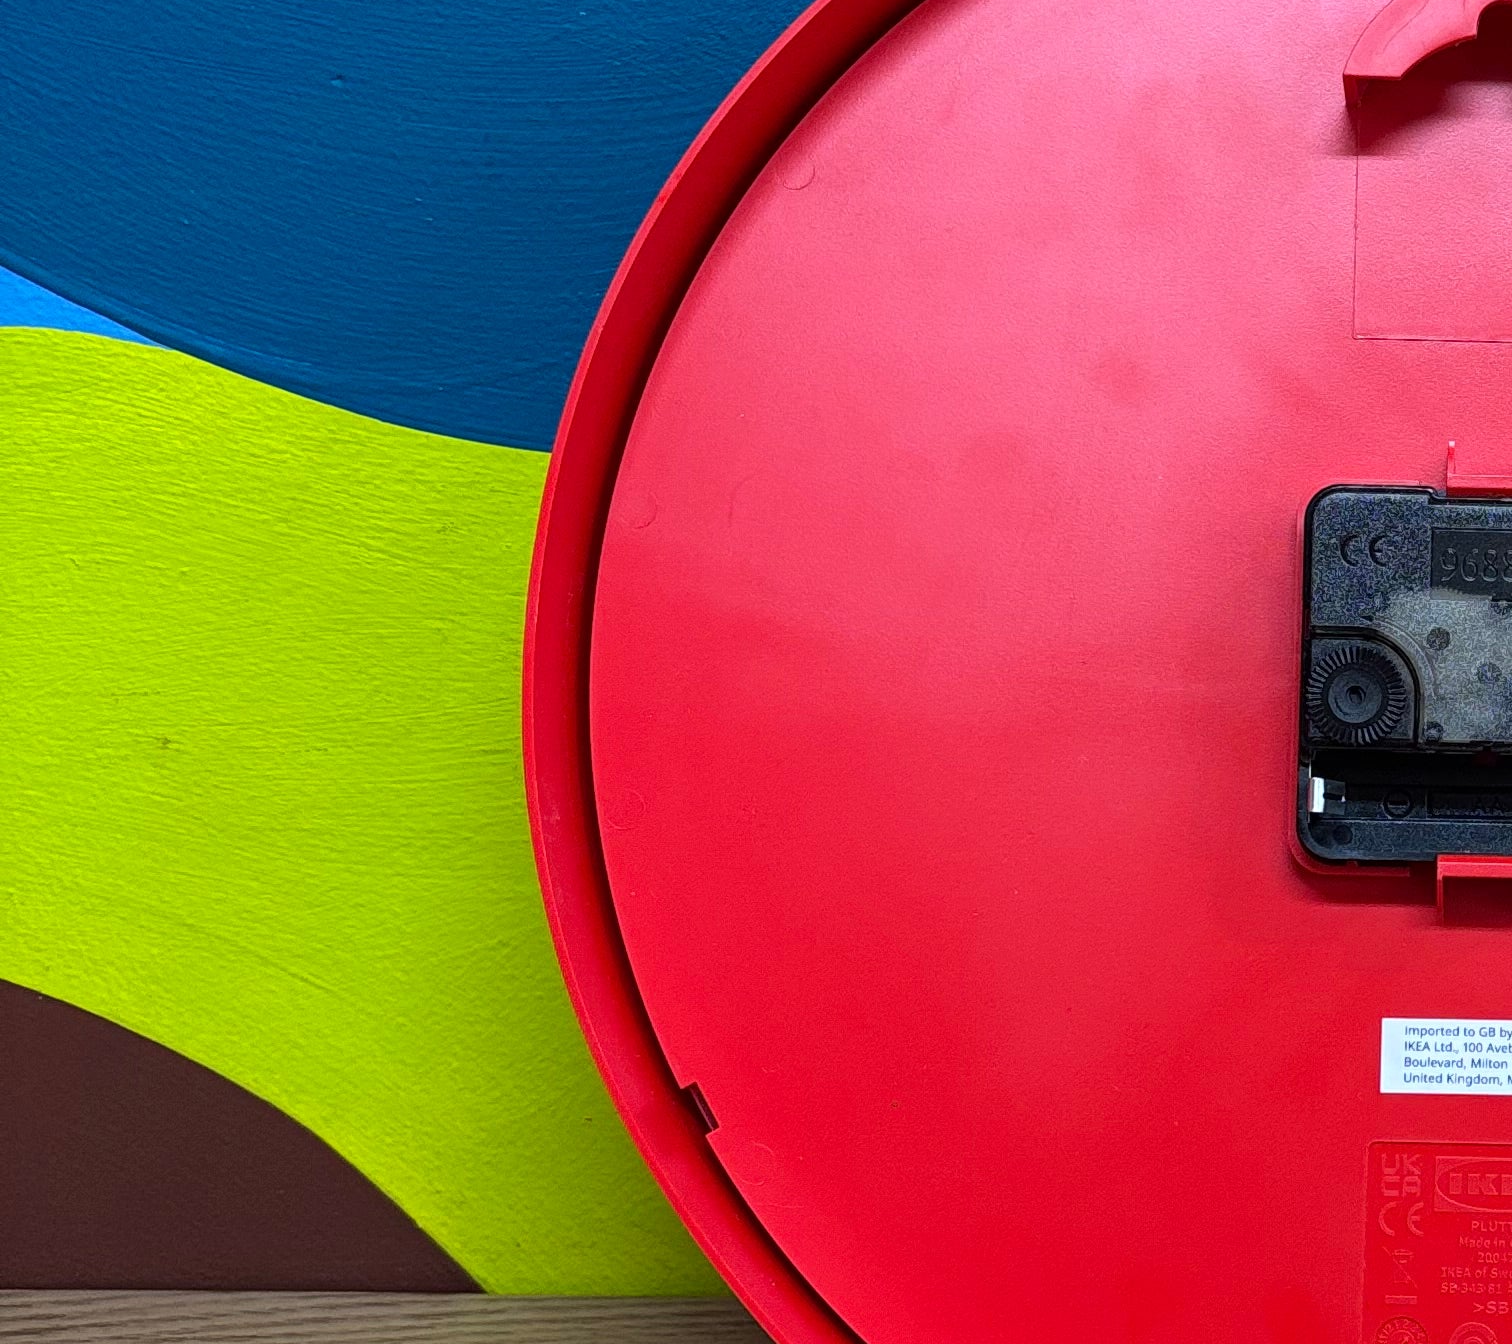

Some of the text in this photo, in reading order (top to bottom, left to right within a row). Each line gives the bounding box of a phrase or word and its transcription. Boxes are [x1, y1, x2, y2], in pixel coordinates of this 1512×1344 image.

[1405, 1026, 1460, 1039] Imported
[1463, 1027, 1475, 1037] to
[1479, 1027, 1496, 1038] GB
[1404, 1042, 1431, 1052] IKEA
[1463, 1043, 1483, 1053] 100
[1404, 1057, 1467, 1070] Boulevard,
[1471, 1058, 1508, 1069] Milton
[1403, 1073, 1442, 1084] United
[1447, 1074, 1503, 1087] Kingdom,
[1459, 1237, 1491, 1248] Made
[1493, 1238, 1506, 1248] in
[1440, 1266, 1471, 1277] IKEA
[1475, 1267, 1488, 1278] of
